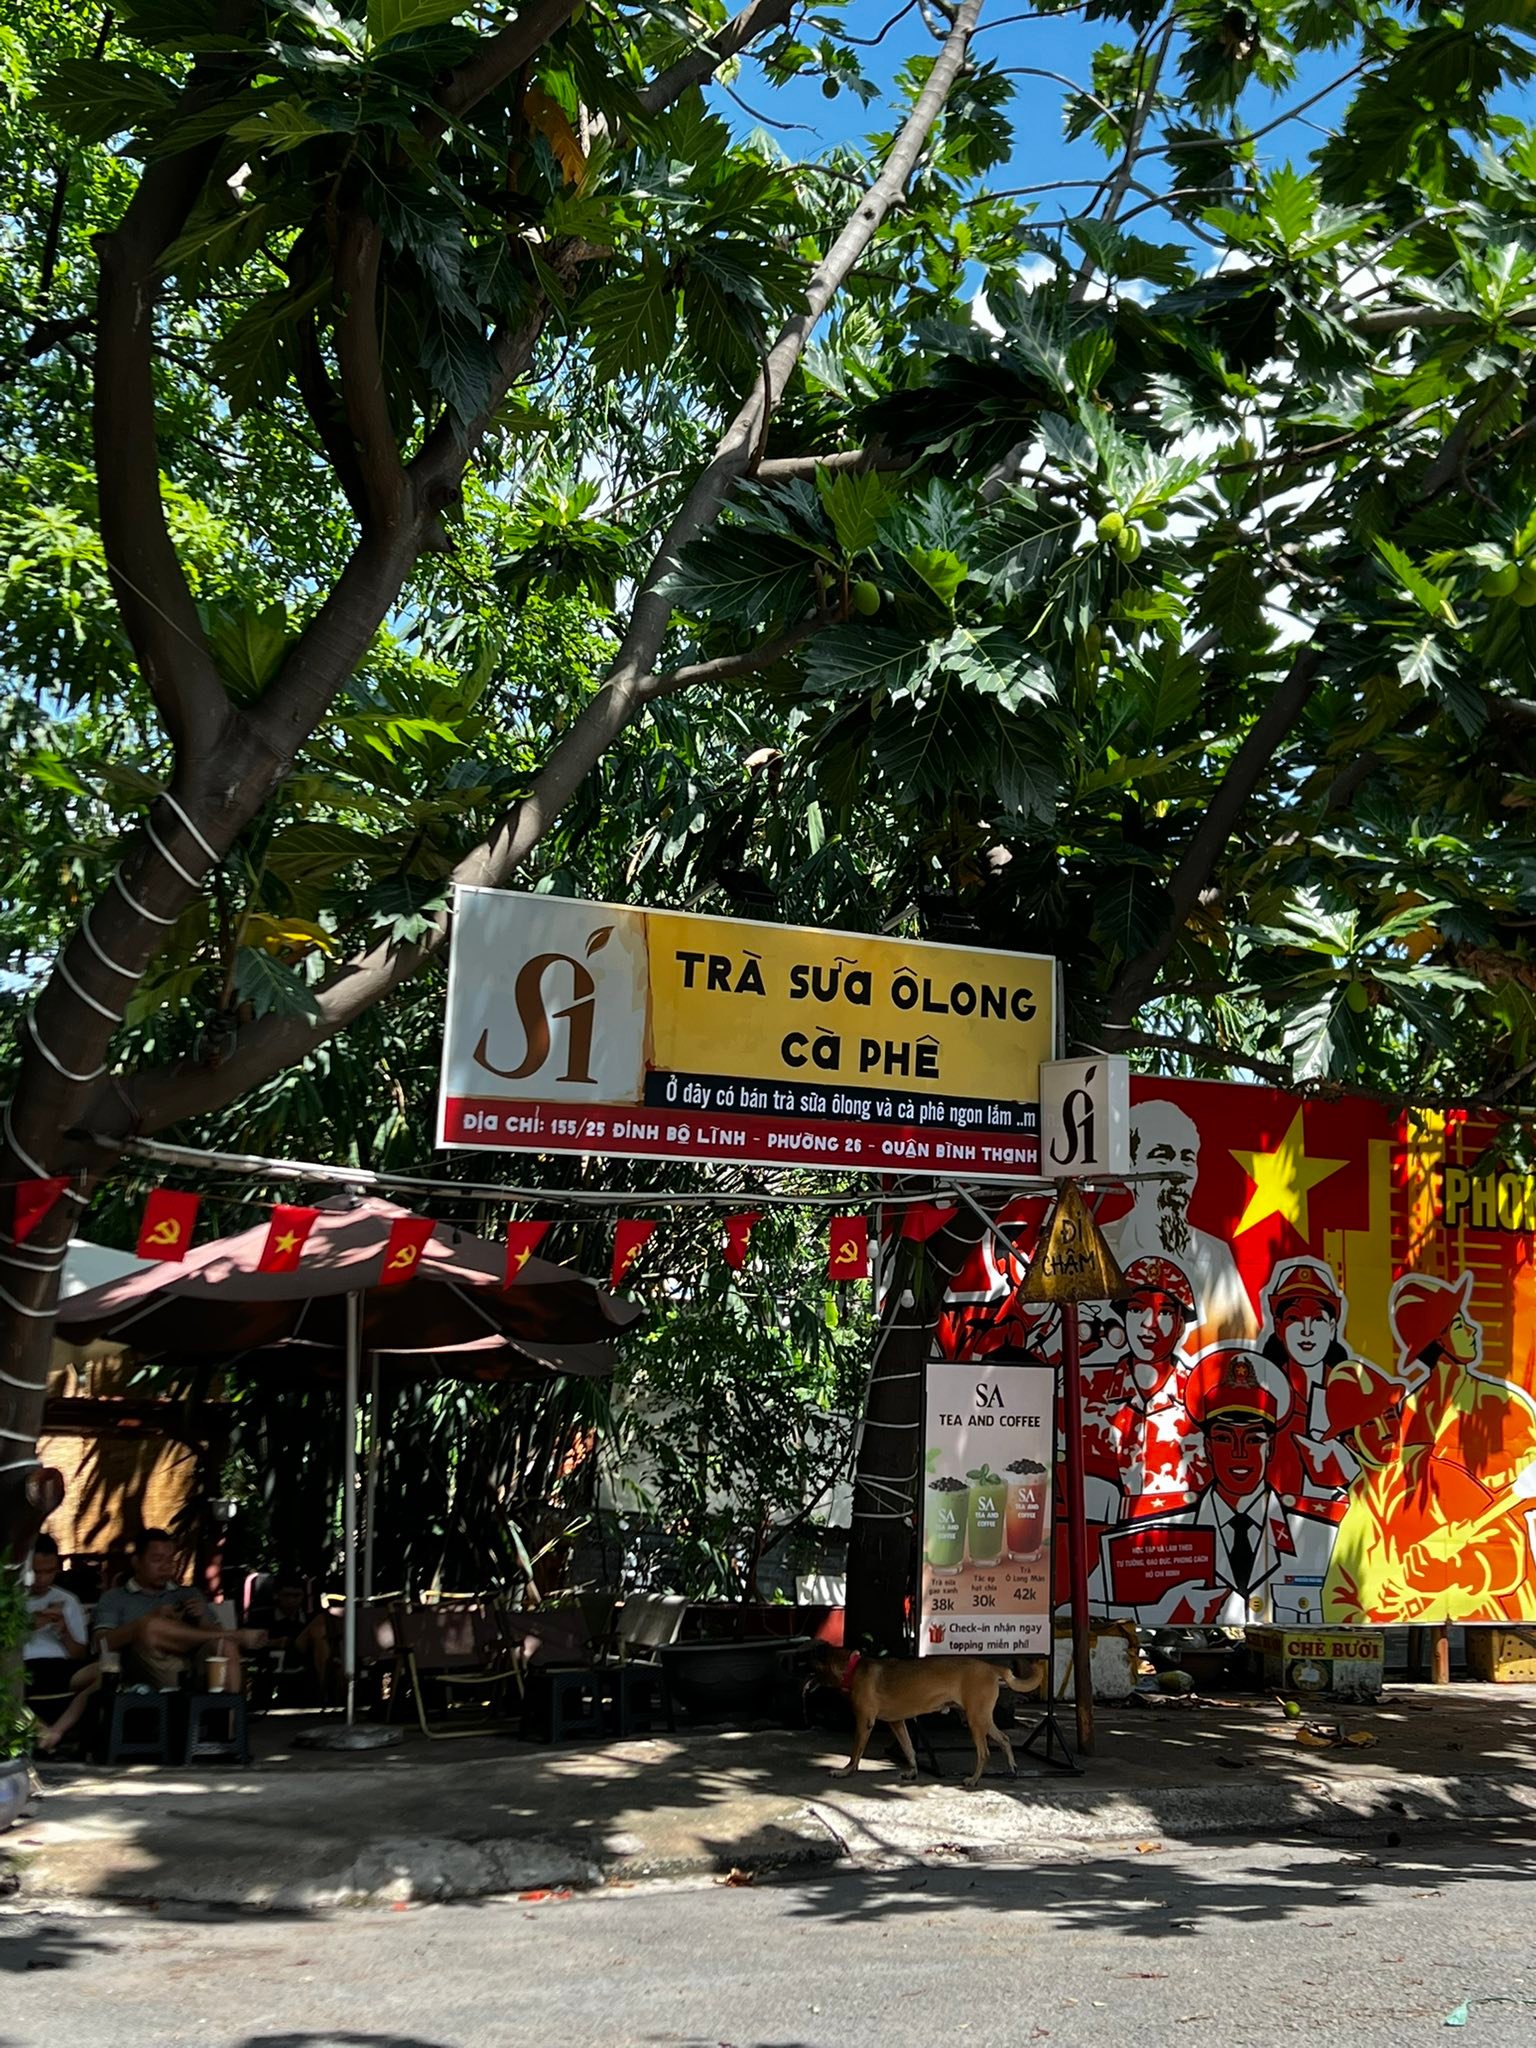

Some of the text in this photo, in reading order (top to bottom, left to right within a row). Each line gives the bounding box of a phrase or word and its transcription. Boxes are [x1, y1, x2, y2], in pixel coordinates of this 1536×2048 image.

[675, 950, 767, 996] TRÀ
[891, 966, 1037, 1022] ÔLONG
[859, 1035, 940, 1079] PHÊ
[666, 1074, 678, 1102] Ở
[683, 1082, 711, 1109] đây
[716, 1086, 734, 1106] có
[740, 1086, 767, 1108] bán
[773, 1090, 794, 1110] trà
[800, 1092, 826, 1113] sữa
[832, 1094, 872, 1120] ôlong
[876, 1097, 892, 1117] và
[898, 1100, 914, 1119] cà
[920, 1101, 945, 1124] phê
[950, 1106, 983, 1127] ngon
[988, 1104, 1012, 1126] lắm
[505, 1105, 544, 1134] CHỈ:
[551, 1117, 606, 1139] 155/25
[666, 1123, 691, 1145] BỘ
[697, 1126, 746, 1146] LĨNH
[767, 1132, 840, 1152] PHƯỜNG
[845, 1138, 862, 1153] 26
[881, 1138, 930, 1159] QUẬN
[936, 1141, 976, 1160] BÌNH
[1042, 1250, 1096, 1277] CHẬM
[976, 1383, 1005, 1408] SA
[939, 1414, 1041, 1427] TEA AND COFFEE
[1018, 1488, 1036, 1503] SA
[978, 1496, 996, 1511] SA
[938, 1508, 956, 1523] SA
[972, 1595, 996, 1607] 30k
[1013, 1588, 1036, 1600] 42k
[931, 1598, 954, 1611] 38k
[949, 1623, 1042, 1634] Check-in nhận ngay
[949, 1641, 984, 1651] topping
[1287, 1638, 1326, 1658] CHÈ
